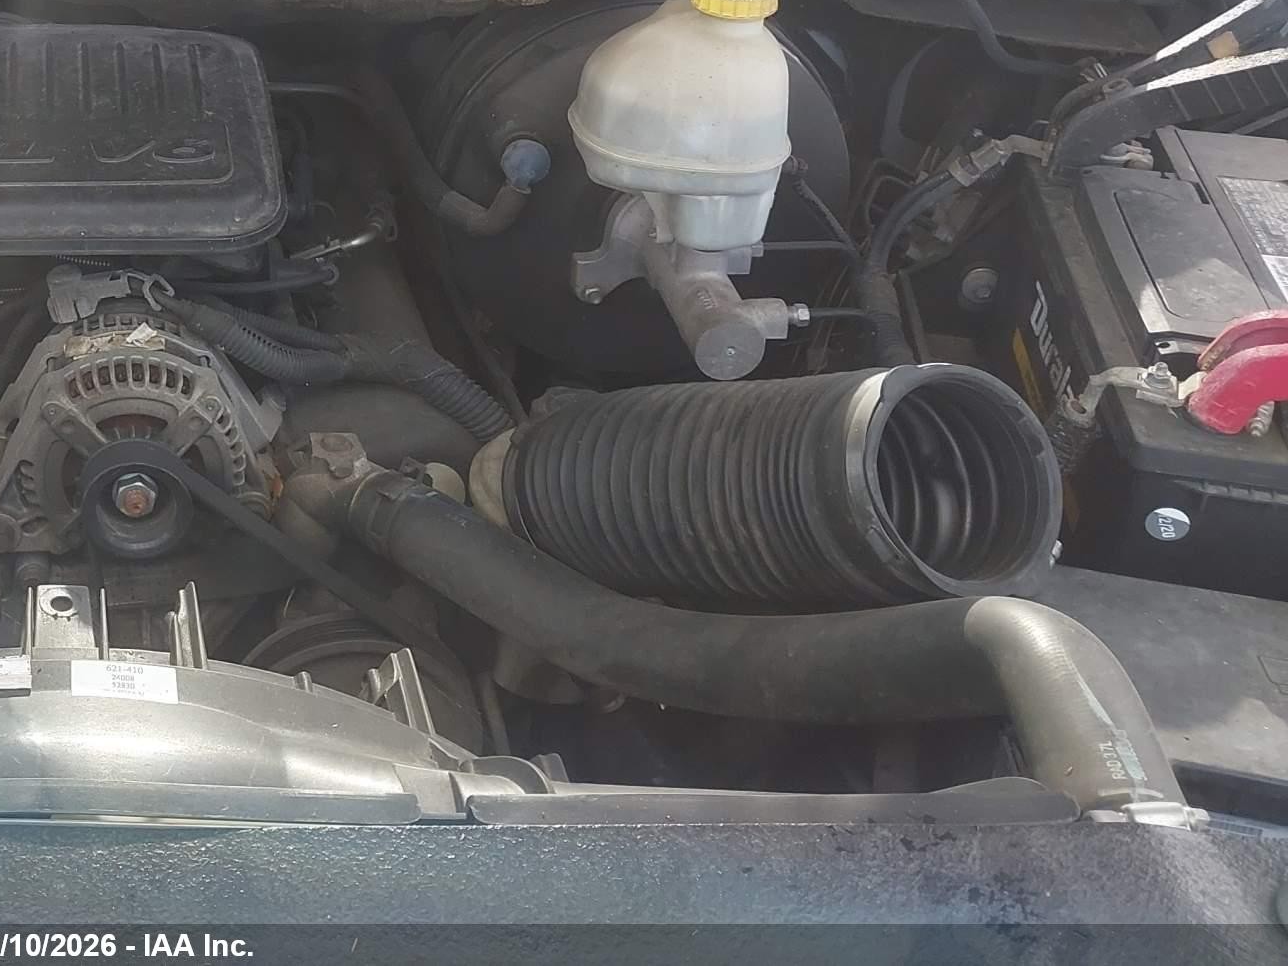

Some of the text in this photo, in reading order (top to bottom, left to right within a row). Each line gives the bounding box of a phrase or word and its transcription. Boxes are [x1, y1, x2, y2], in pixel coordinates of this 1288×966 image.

[88, 138, 216, 165] V6
[1030, 280, 1076, 402] Dural
[106, 664, 143, 674] 621-410
[1106, 760, 1128, 780] RAD
